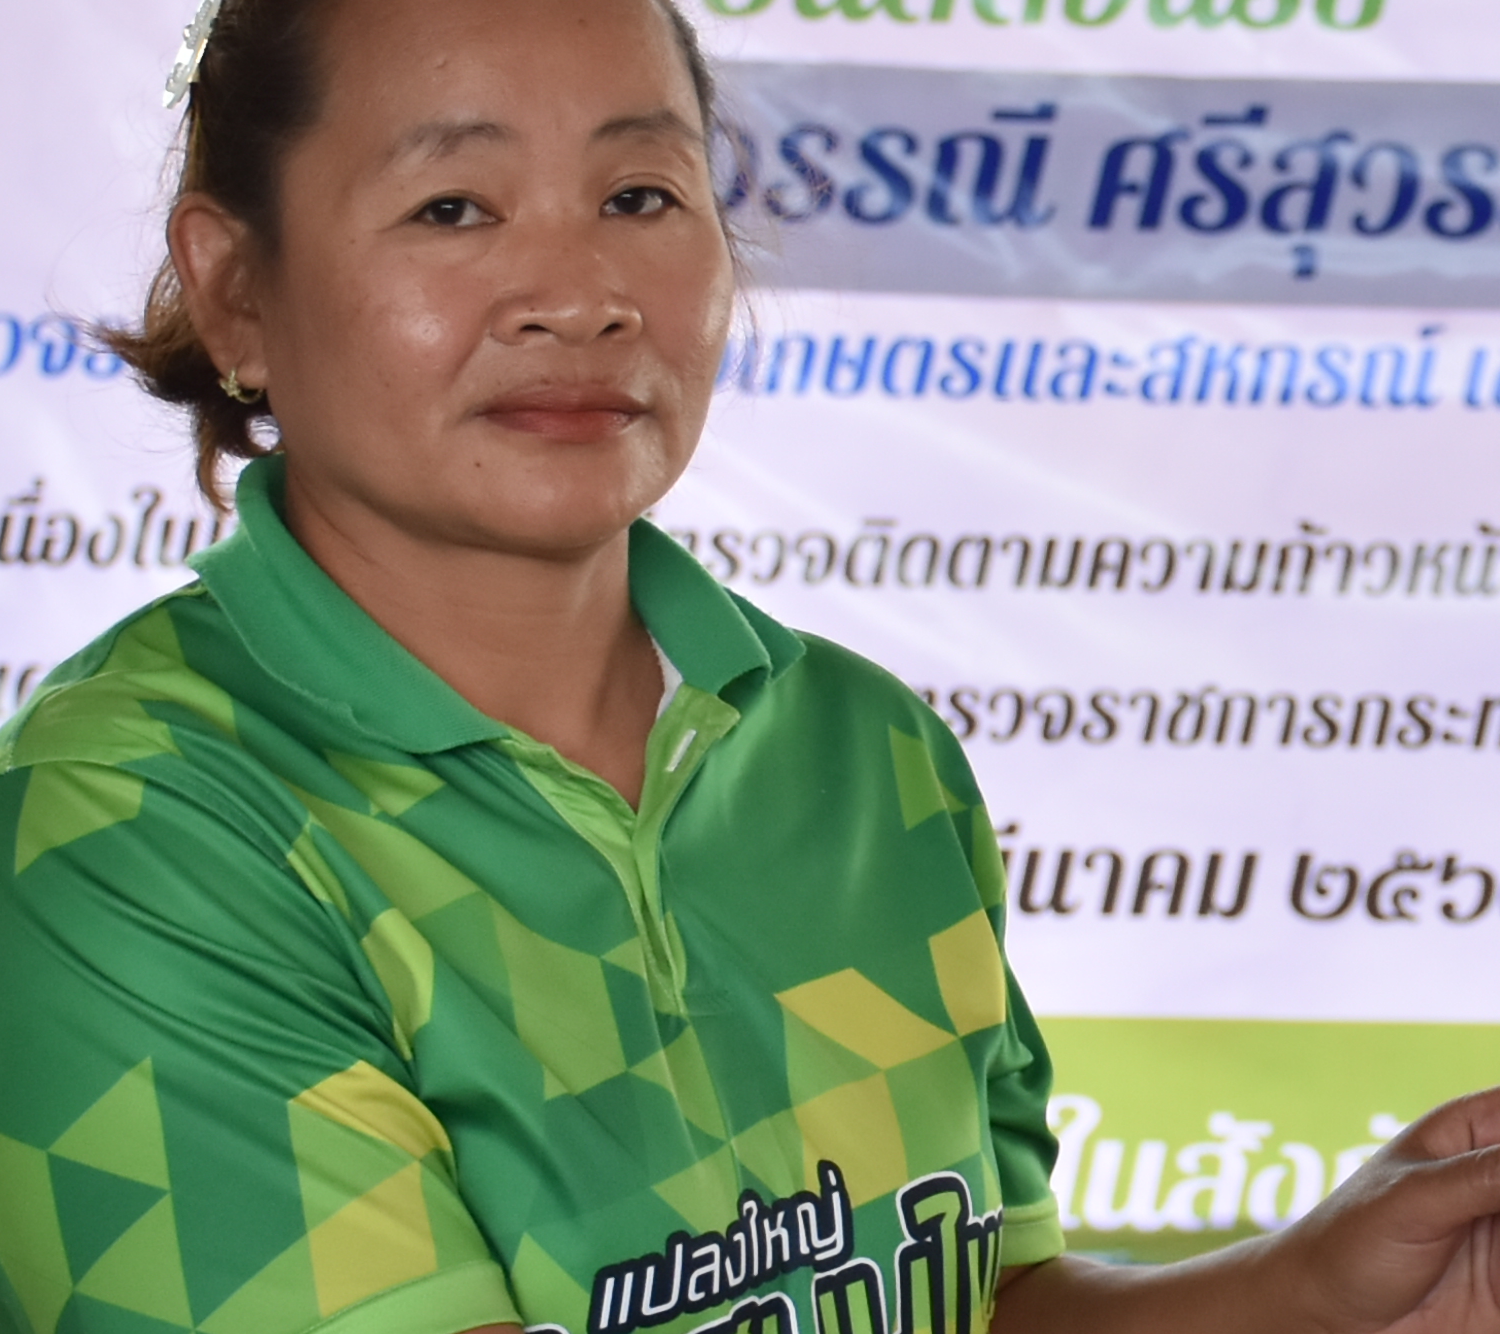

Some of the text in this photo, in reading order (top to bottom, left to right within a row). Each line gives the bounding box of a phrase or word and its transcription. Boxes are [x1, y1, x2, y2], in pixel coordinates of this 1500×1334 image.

[996, 821, 1262, 921] นาคม
[1045, 1094, 1412, 1233] ในสัง
[599, 1168, 846, 1330] แปลงใหญ่
